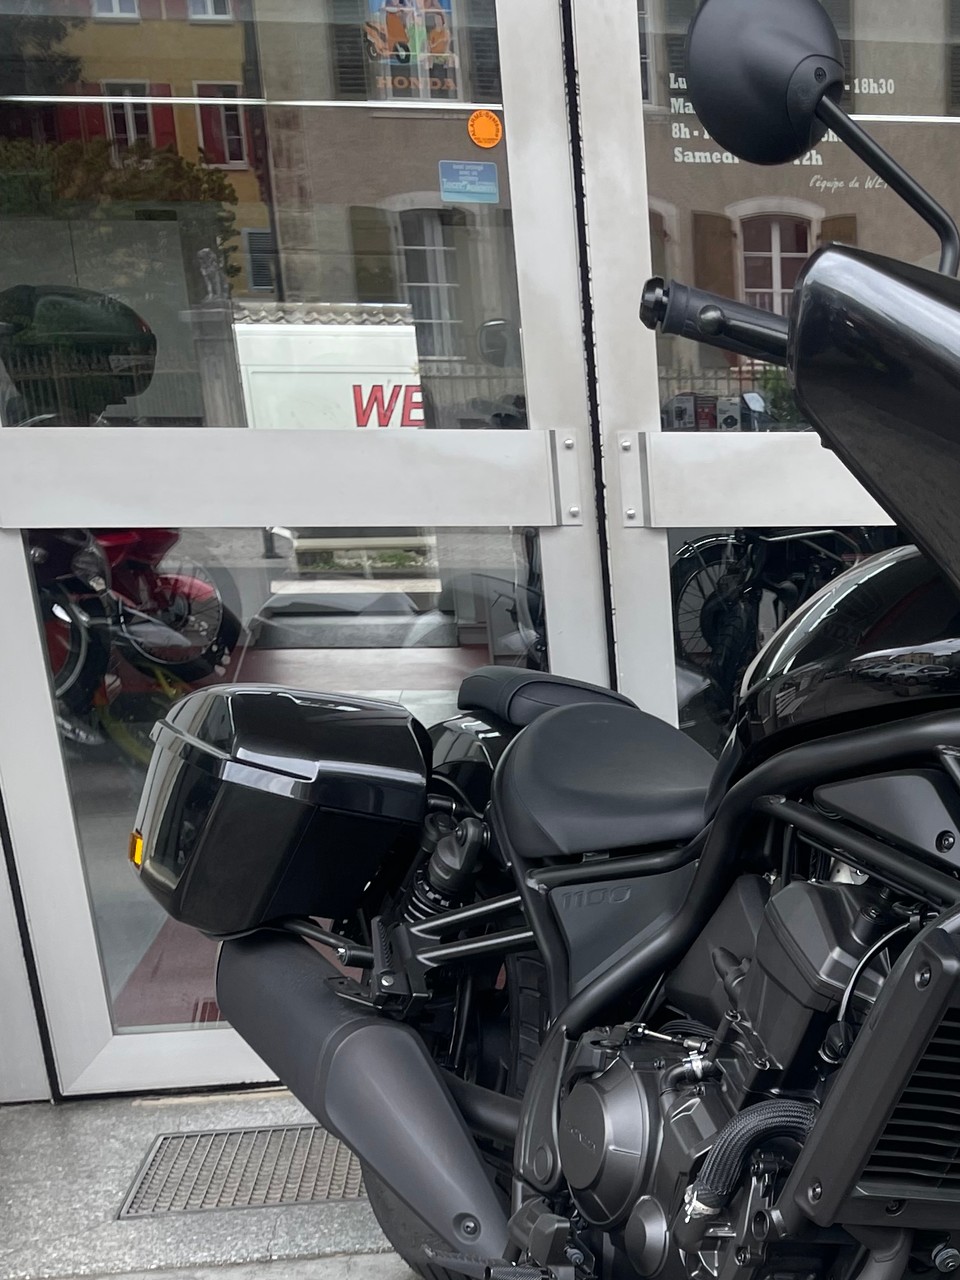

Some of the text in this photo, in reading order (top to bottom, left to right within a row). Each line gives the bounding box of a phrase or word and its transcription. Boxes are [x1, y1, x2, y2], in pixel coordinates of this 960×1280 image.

[376, 76, 457, 91] HONDA
[669, 73, 687, 89] Lu
[854, 78, 895, 94] 18h30
[670, 98, 696, 114] Ma
[672, 122, 691, 139] 8h
[561, 885, 632, 910] 1100
